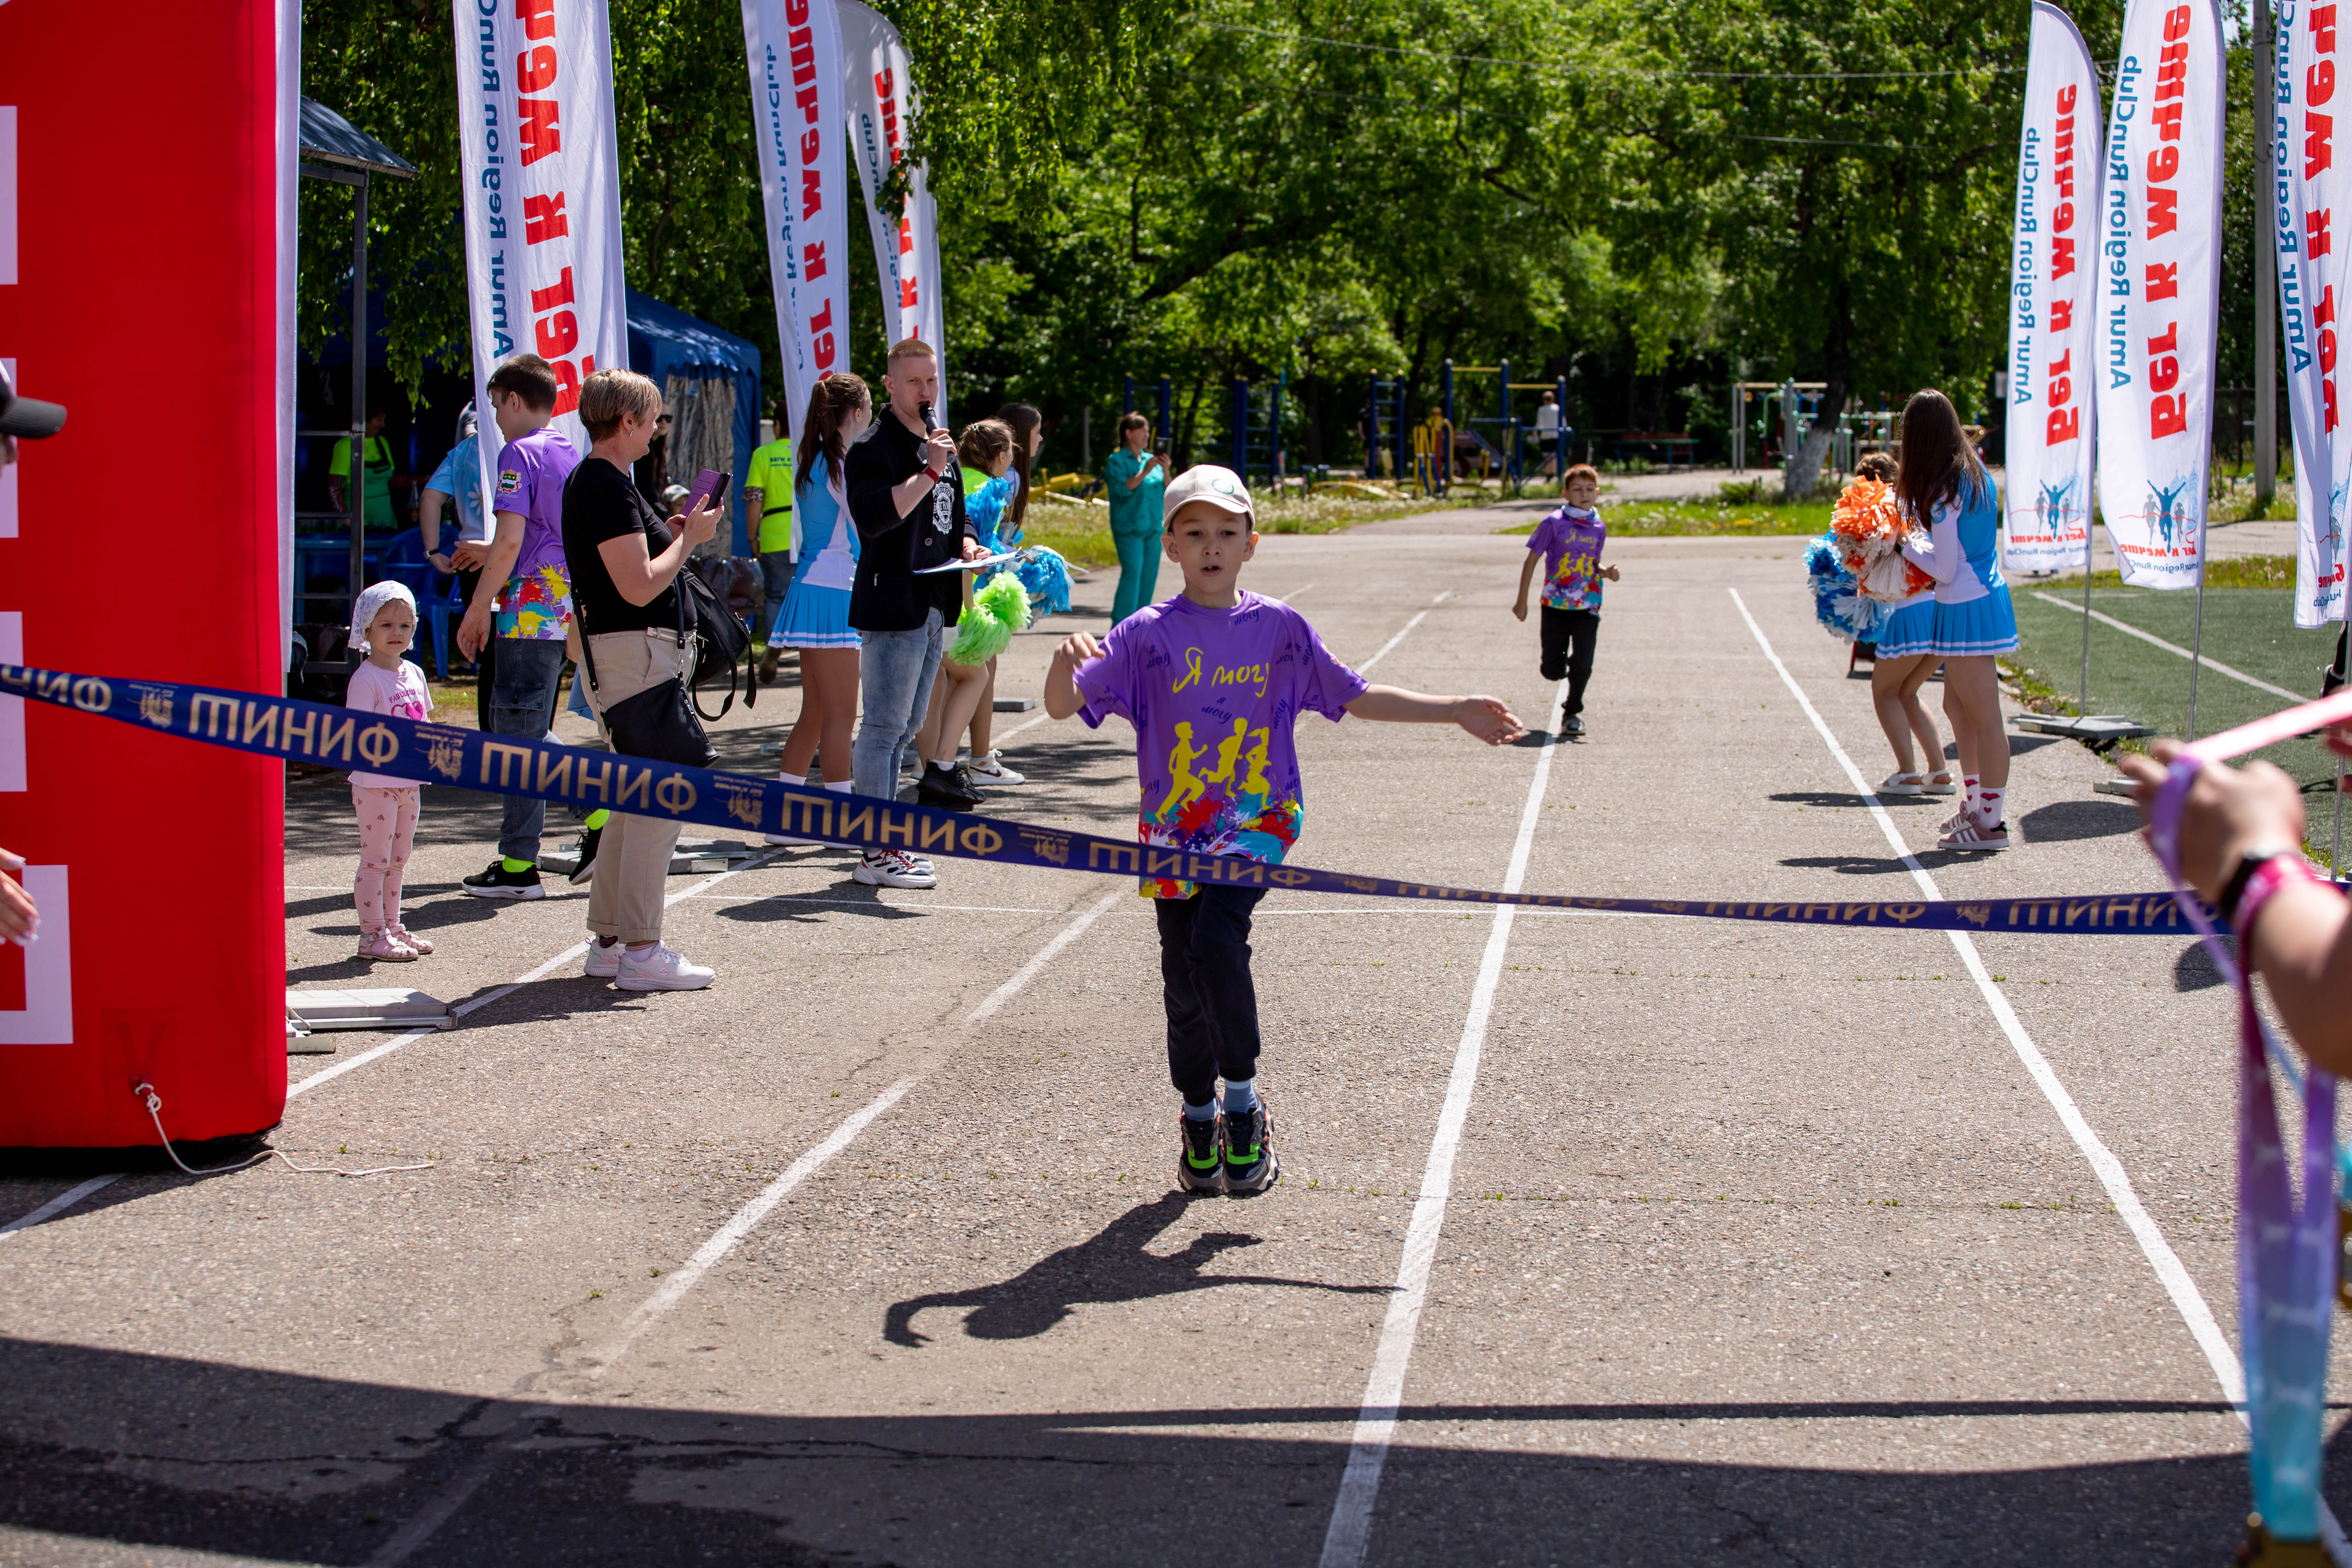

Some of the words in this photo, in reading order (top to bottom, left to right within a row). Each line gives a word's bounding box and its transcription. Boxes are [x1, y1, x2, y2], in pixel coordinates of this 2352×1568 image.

[389, 688, 416, 703] FABULOUS
[1173, 647, 1204, 694] Я
[1211, 662, 1269, 698] могу
[188, 693, 400, 768] ФИНИШ
[1201, 706, 1233, 724] могу
[480, 741, 698, 815] ФИНИШ
[781, 792, 1003, 856] ФИНИШ
[1089, 841, 1312, 887] ФИНИШ
